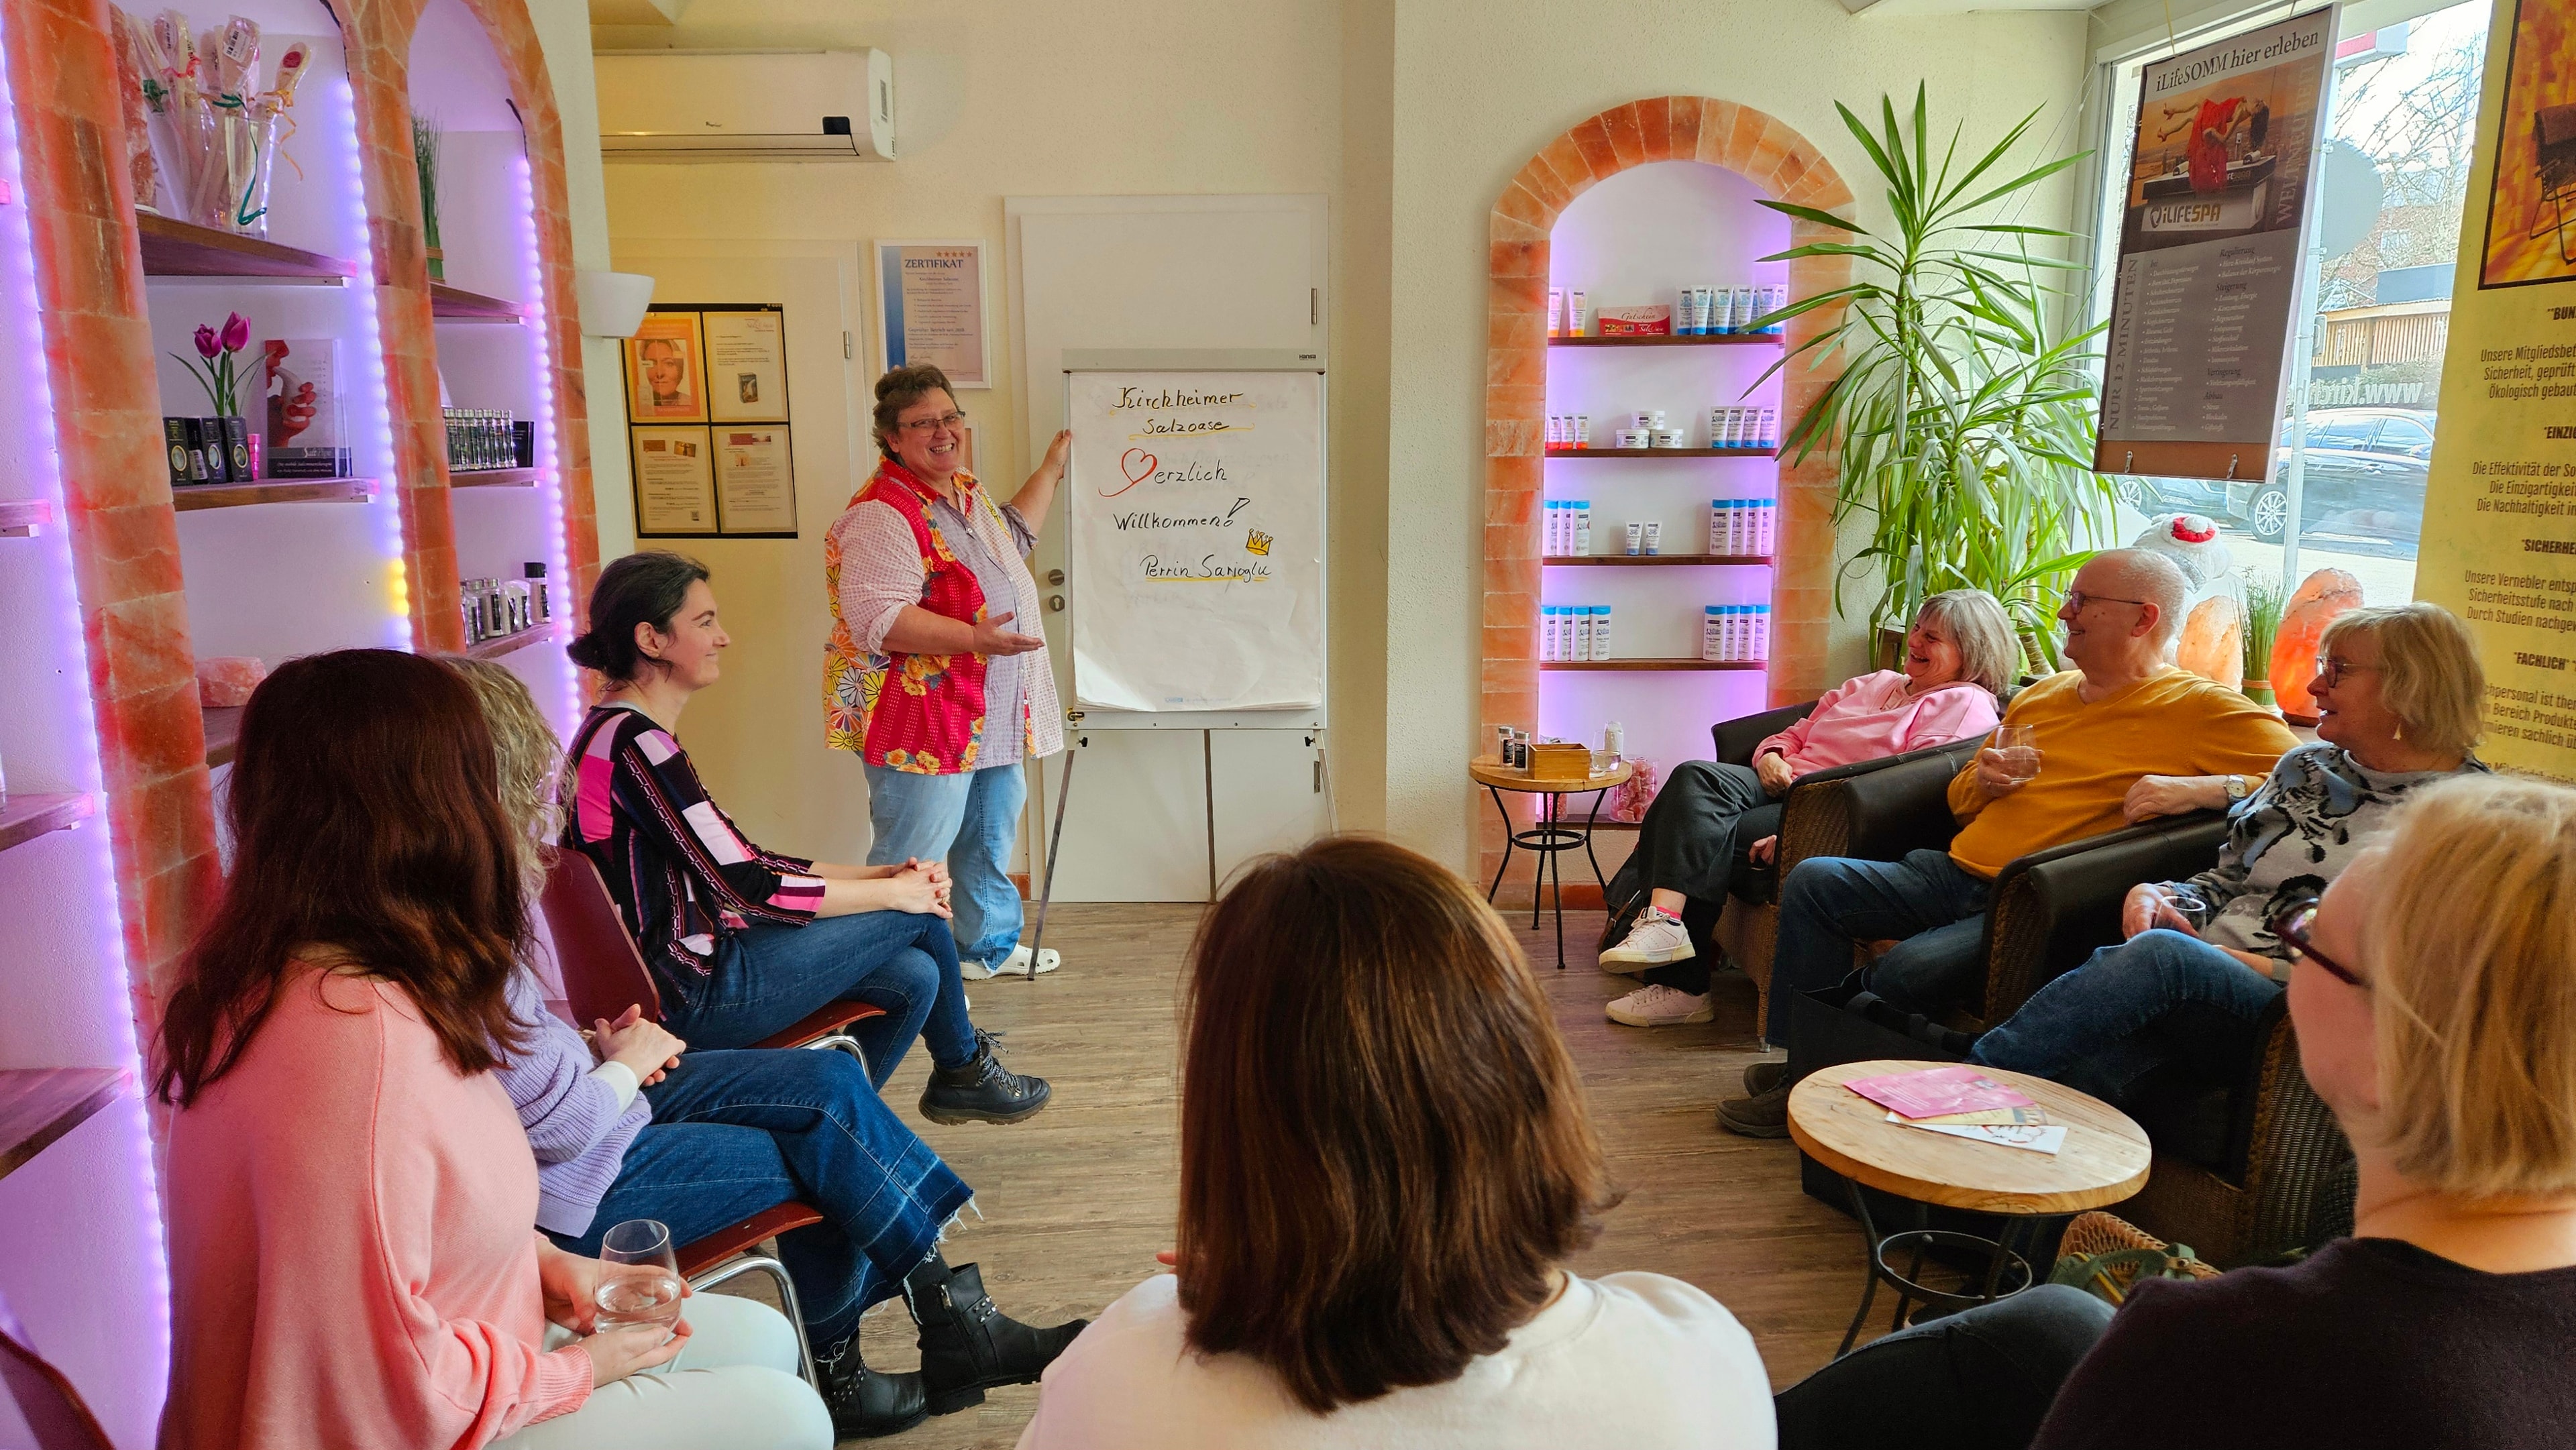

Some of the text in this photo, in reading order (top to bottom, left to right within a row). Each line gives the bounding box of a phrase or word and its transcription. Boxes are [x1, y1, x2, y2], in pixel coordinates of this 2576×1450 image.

[2155, 31, 2319, 92] iLifeSOMM hier erleben
[904, 259, 964, 269] ZERTIFIKAT
[2547, 306, 2576, 321] "BUN
[2109, 258, 2138, 431] NUR 12 MINUTEN
[2481, 349, 2513, 362] Unsere
[2484, 362, 2576, 382] Sicherheit, geprüft
[1112, 387, 1244, 409] Kirchheimer
[2489, 382, 2576, 401] Ökologisch gebaut
[1142, 419, 1230, 435] Salzoase
[2473, 461, 2576, 478] Die Effektivität der So
[2489, 480, 2504, 494] Die
[1112, 497, 1250, 531] Willkommen!
[2477, 497, 2491, 512] Die
[2492, 498, 2565, 518] Nachhaltigkeit
[2522, 539, 2576, 555] "SICHERHE
[1140, 554, 1194, 578] Perrin
[2465, 569, 2496, 585] Unsere
[2498, 573, 2547, 590] Vernebler
[2469, 588, 2574, 612] Sicherheitsstufe nach
[2467, 606, 2494, 622] Durch
[2496, 609, 2534, 626] Studien
[2540, 690, 2555, 707] ist
[2493, 702, 2530, 722] Bereich
[2522, 728, 2564, 747] sachlich
